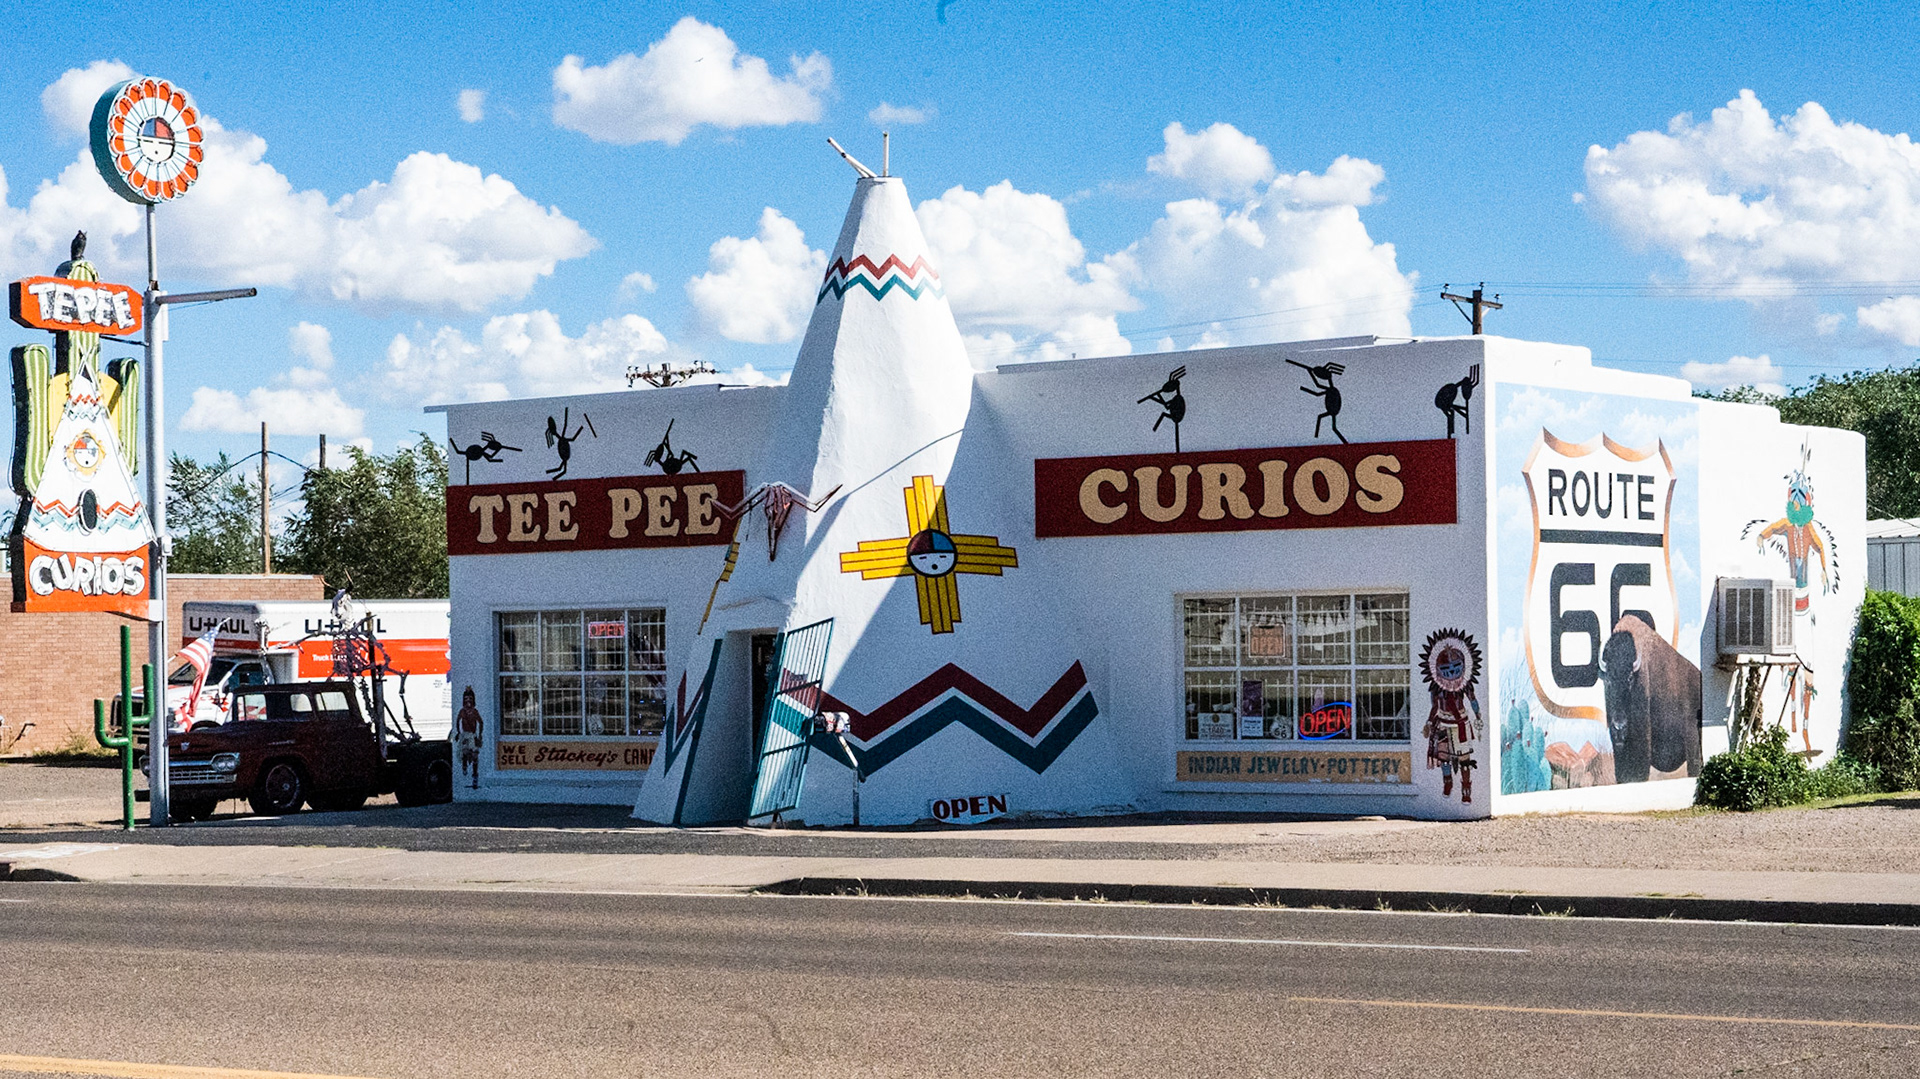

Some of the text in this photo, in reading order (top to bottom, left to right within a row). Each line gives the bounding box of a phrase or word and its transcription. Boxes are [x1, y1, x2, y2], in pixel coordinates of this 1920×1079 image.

[28, 282, 136, 330] TEPEE
[1079, 453, 1404, 524] CURIOS
[1548, 468, 1656, 521] ROUTE
[469, 483, 722, 544] TEE PEE
[29, 553, 146, 597] CURIOS
[591, 623, 625, 637] OPEN
[1550, 562, 1657, 689] 66
[1300, 707, 1352, 736] OPEN
[501, 755, 529, 766] SELL
[502, 745, 526, 755] WE
[534, 746, 619, 767] Stuckey's
[1188, 756, 1402, 775] INDIAN JEWELRY POTTERY
[932, 794, 1008, 820] OPEN
